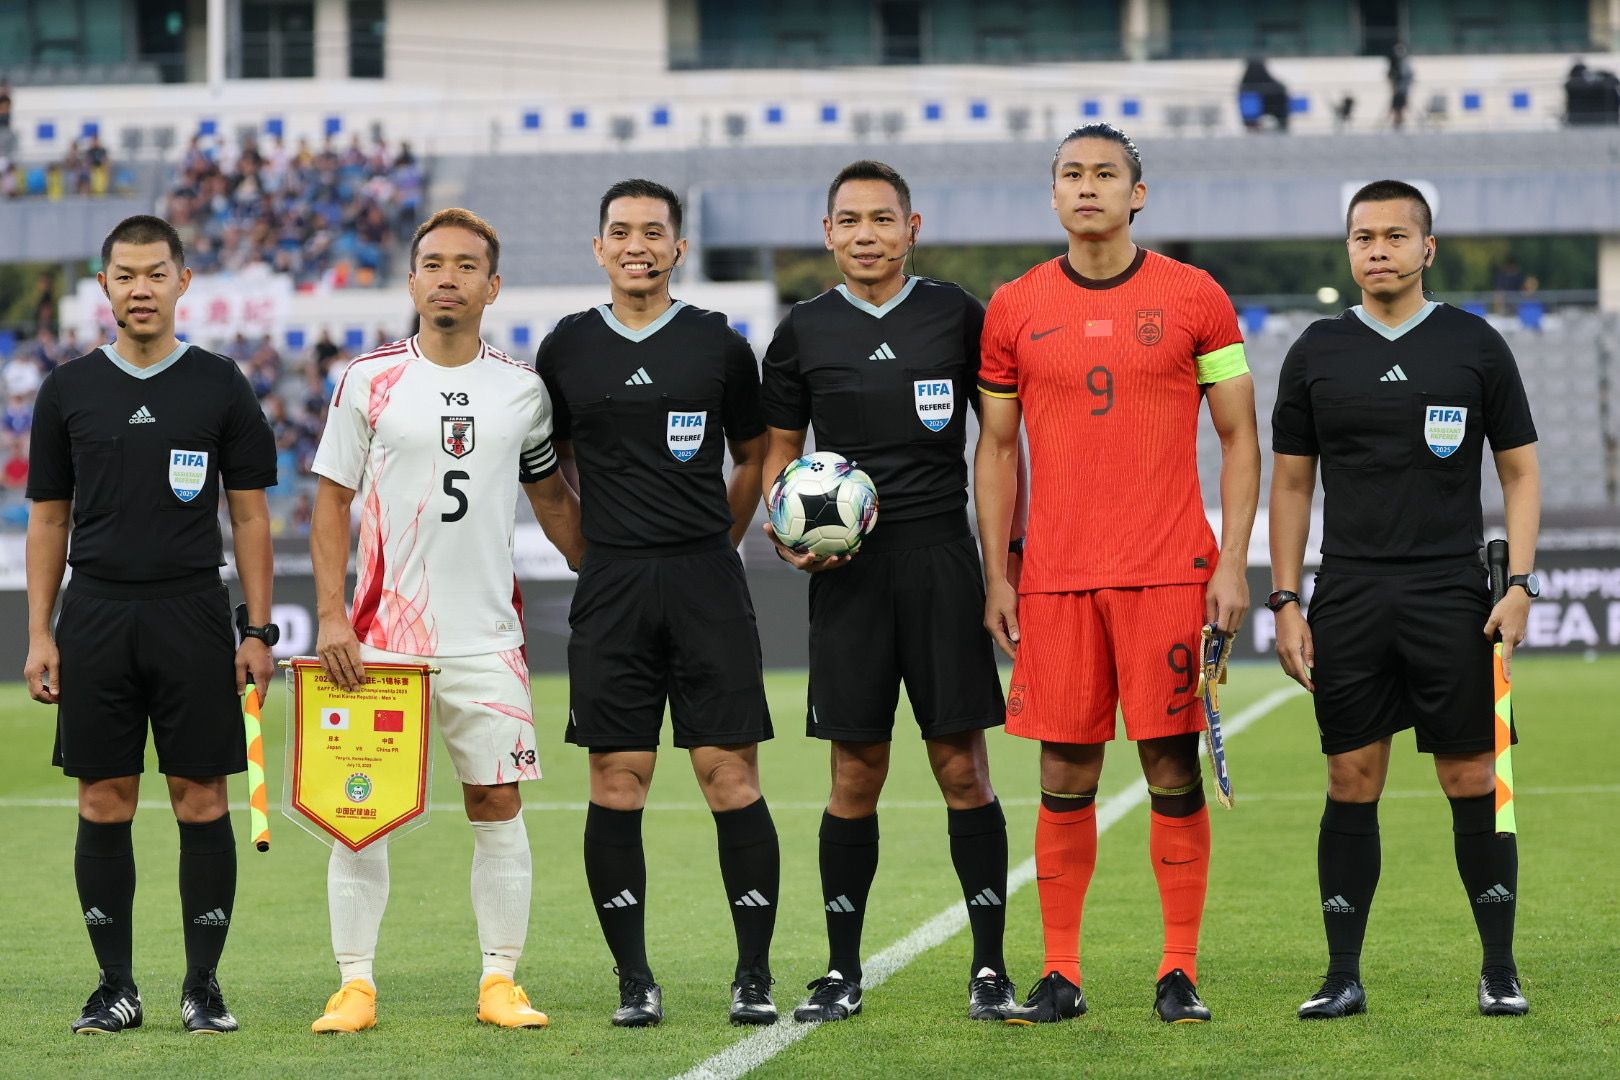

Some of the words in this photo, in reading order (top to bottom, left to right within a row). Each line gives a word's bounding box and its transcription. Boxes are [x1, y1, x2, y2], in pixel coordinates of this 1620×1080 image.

[918, 383, 950, 396] FIFA
[1087, 366, 1113, 416] 9
[440, 392, 470, 406] Y-3
[919, 403, 951, 411] REFEREE
[128, 416, 156, 424] adidas
[671, 415, 702, 427] FIFA
[1429, 410, 1462, 422] FIFA
[670, 434, 701, 442] REFEREE
[173, 454, 204, 467] FIFA
[441, 470, 470, 522] 5
[1168, 643, 1194, 694] 9
[382, 737, 394, 745] 中国
[510, 749, 536, 767] Y-3
[1476, 893, 1514, 904] adidas
[193, 917, 229, 926] adidas
